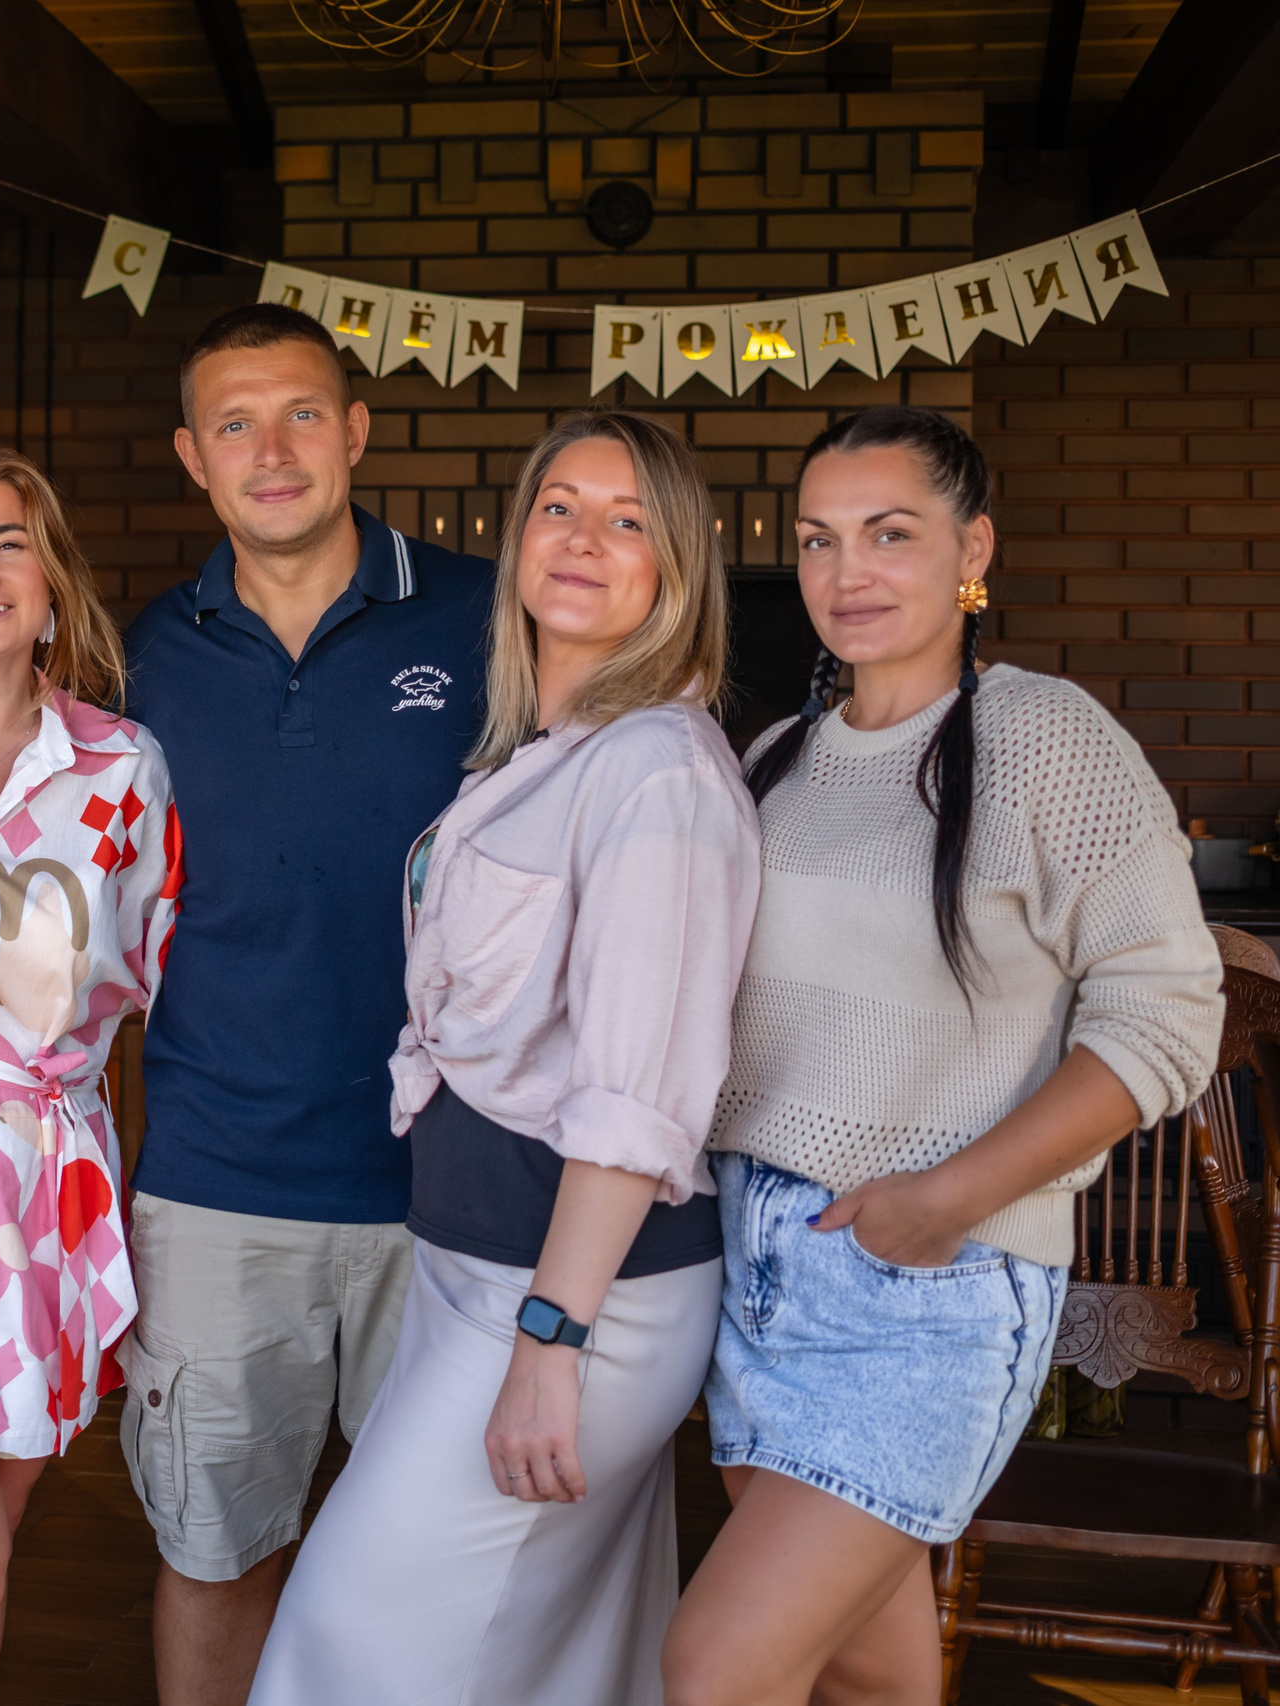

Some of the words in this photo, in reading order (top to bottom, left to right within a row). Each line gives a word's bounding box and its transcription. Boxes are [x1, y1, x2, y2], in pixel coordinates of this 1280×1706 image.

[113, 240, 148, 276] С
[607, 234, 1140, 362] РОЖДЕНИЯ
[390, 668, 412, 687] PAUL
[411, 665, 420, 674] &
[419, 665, 453, 686] SHARK
[391, 693, 446, 712] yachting
